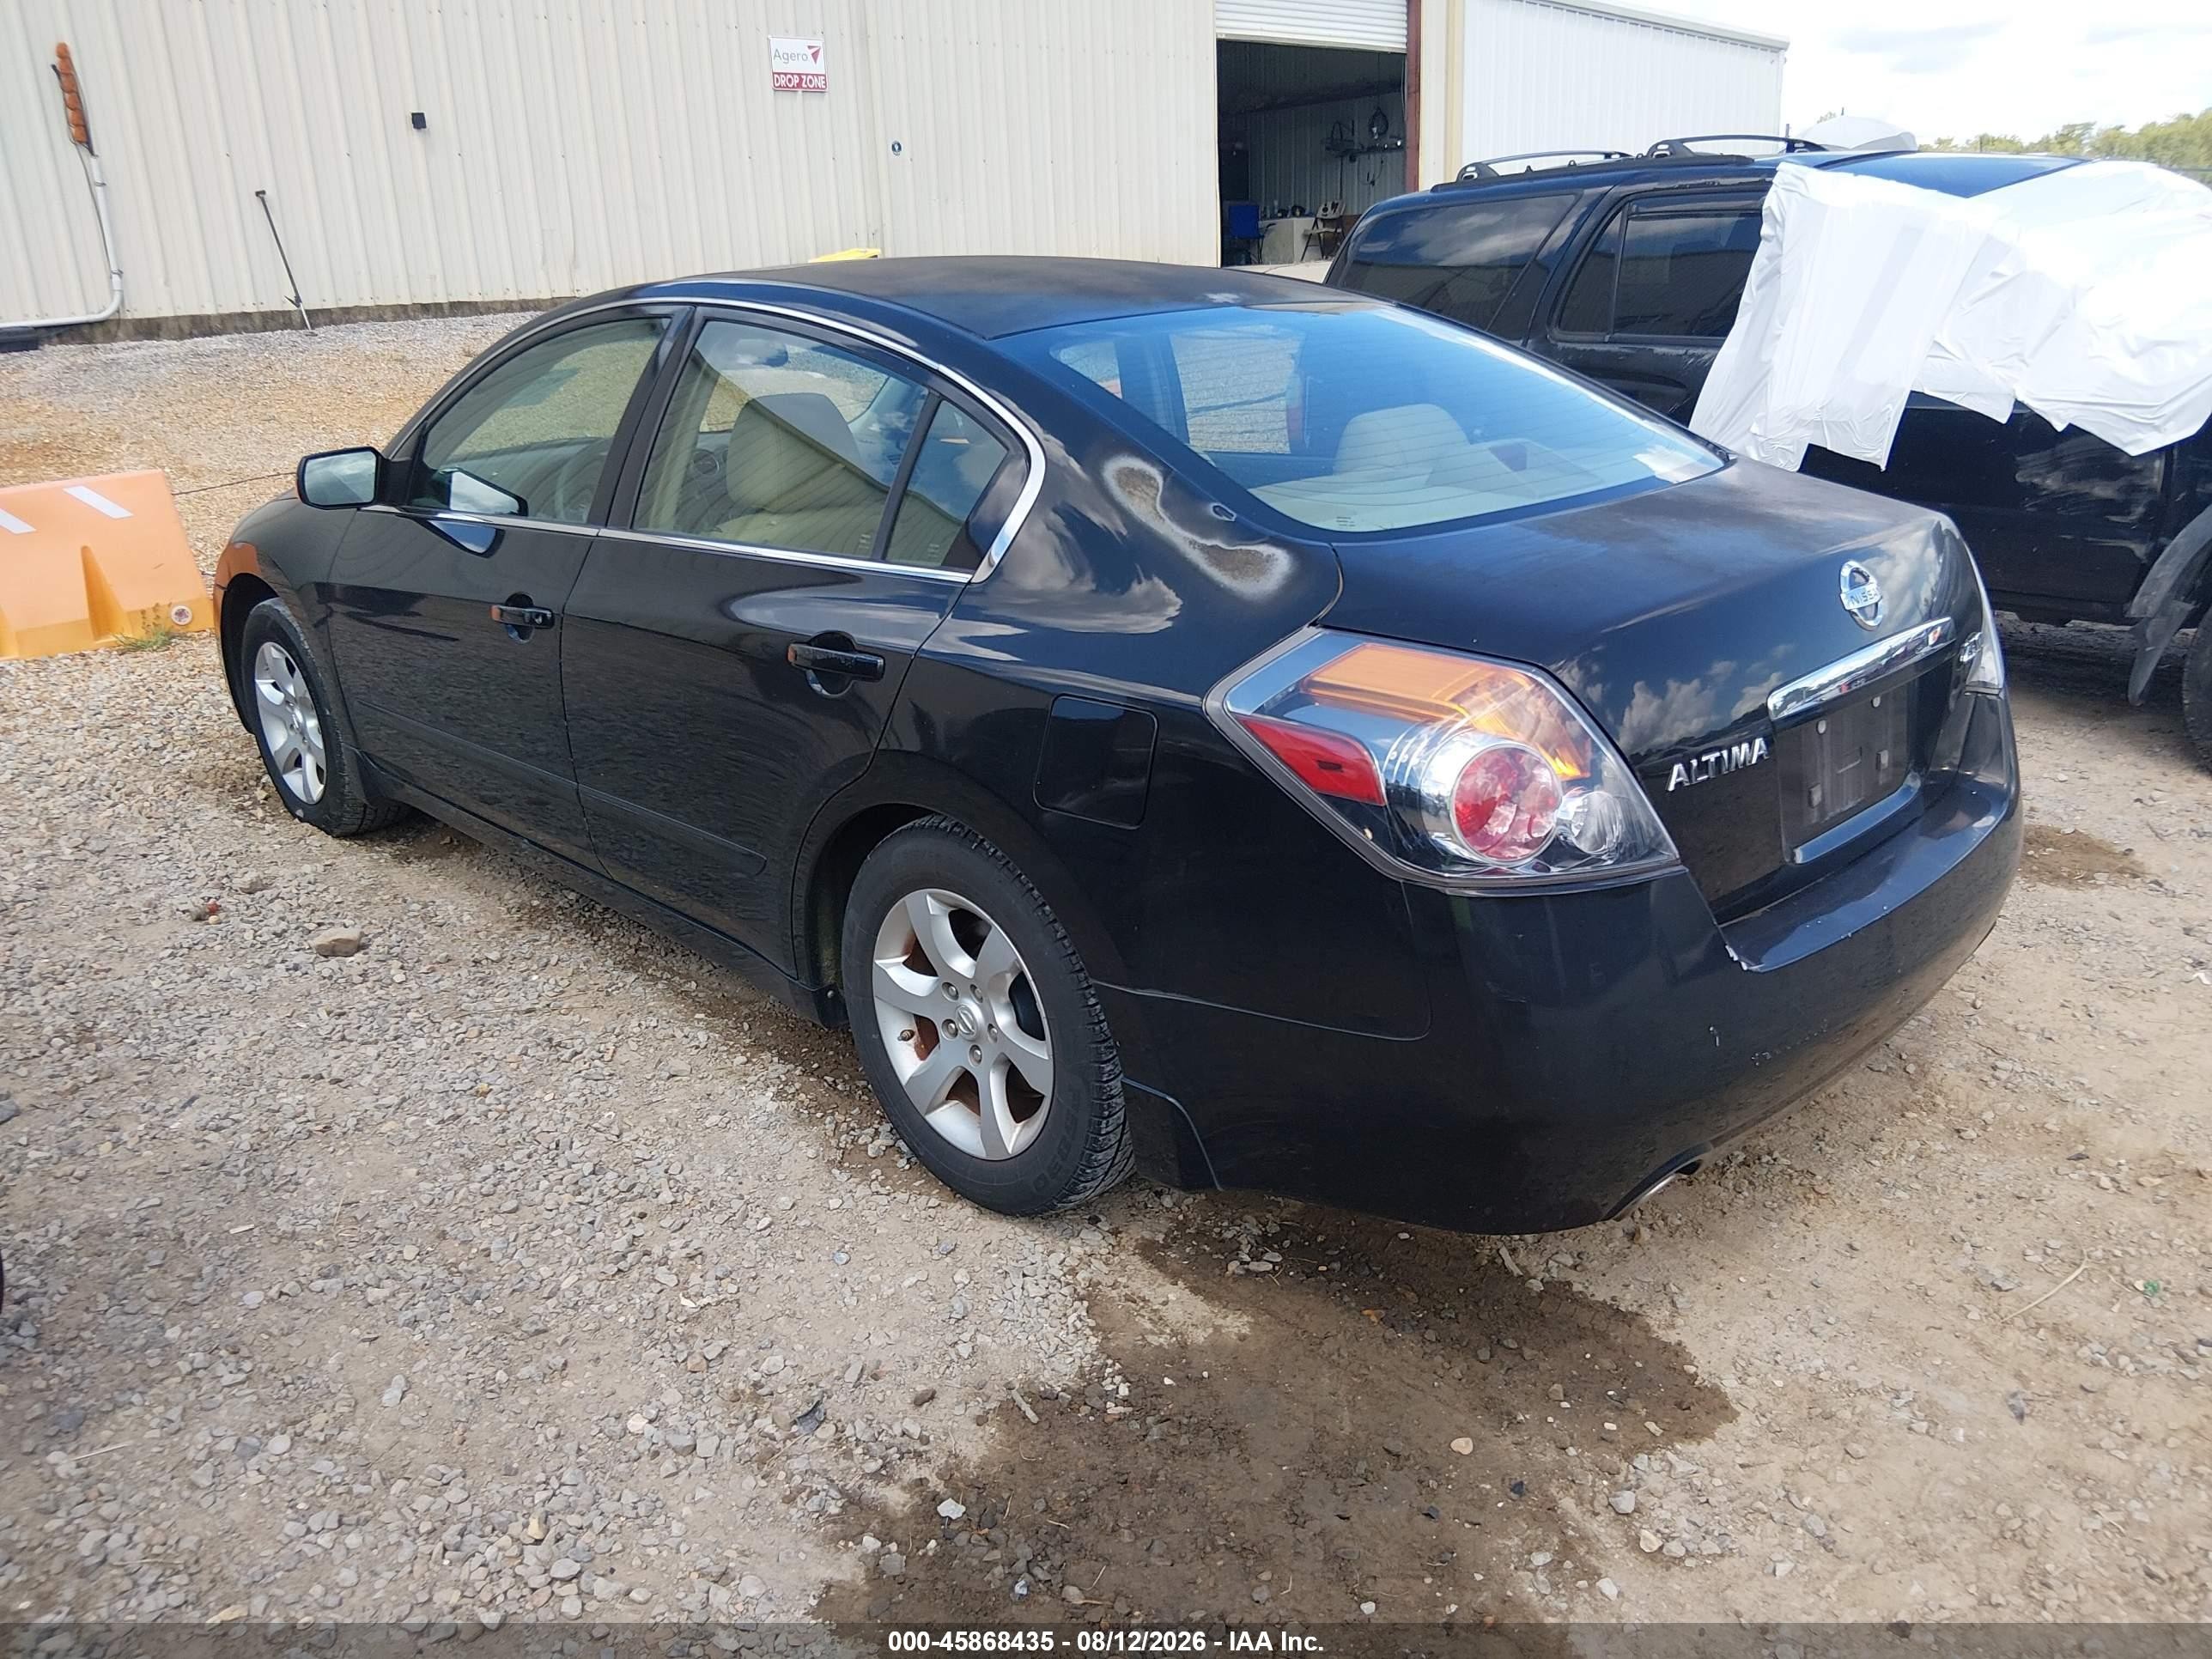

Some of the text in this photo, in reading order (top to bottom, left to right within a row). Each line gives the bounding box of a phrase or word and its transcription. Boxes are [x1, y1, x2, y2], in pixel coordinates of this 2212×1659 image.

[774, 49, 808, 64] Agero
[774, 74, 826, 89] DROP ZONE
[1848, 588, 1880, 606] NISSA
[1665, 738, 1770, 792] ALTIMA
